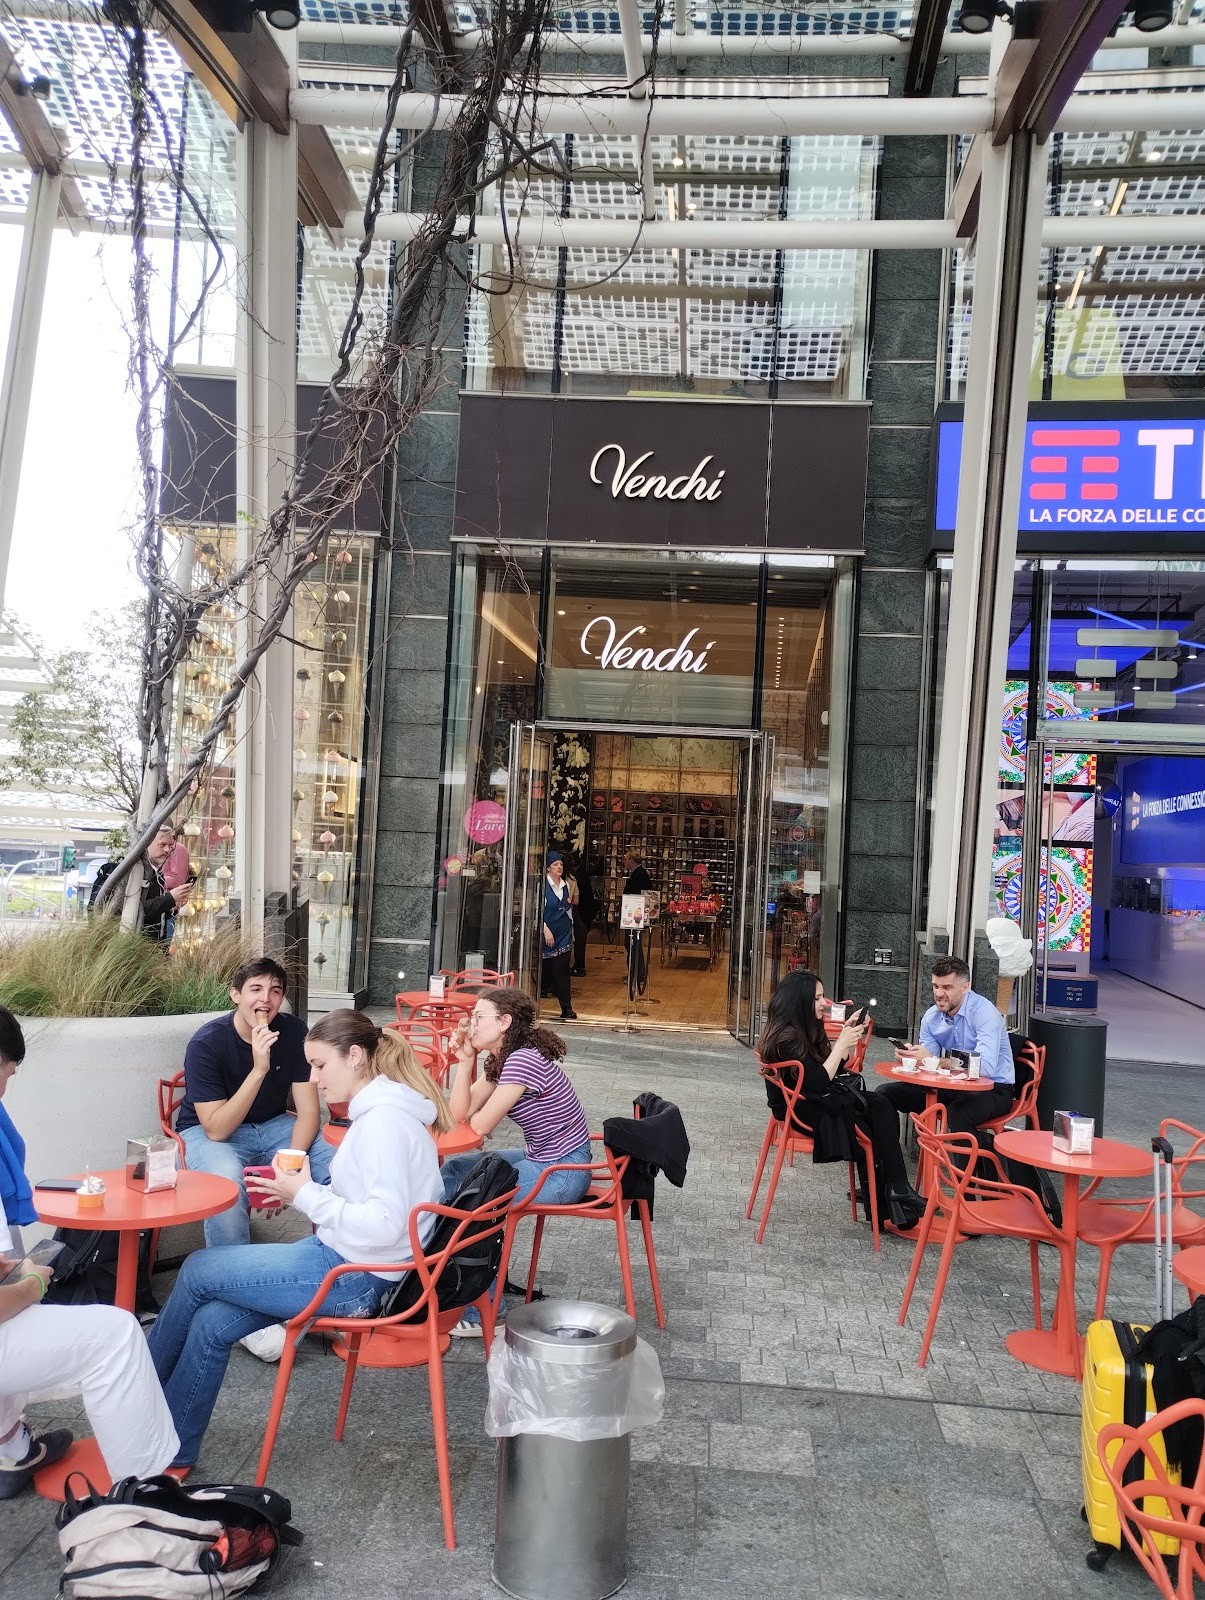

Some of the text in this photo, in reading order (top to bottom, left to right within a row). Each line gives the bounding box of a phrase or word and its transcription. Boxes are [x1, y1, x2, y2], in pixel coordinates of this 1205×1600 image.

[590, 444, 726, 501] Venchi
[1138, 429, 1205, 500] T
[1029, 508, 1053, 523] LA
[1057, 508, 1117, 523] FORZA
[1122, 508, 1177, 523] DELLE
[580, 616, 716, 673] Venchi
[475, 819, 505, 831] Love
[1142, 803, 1149, 818] LA
[1148, 800, 1163, 817] FORZA
[1162, 796, 1177, 814] DELLE
